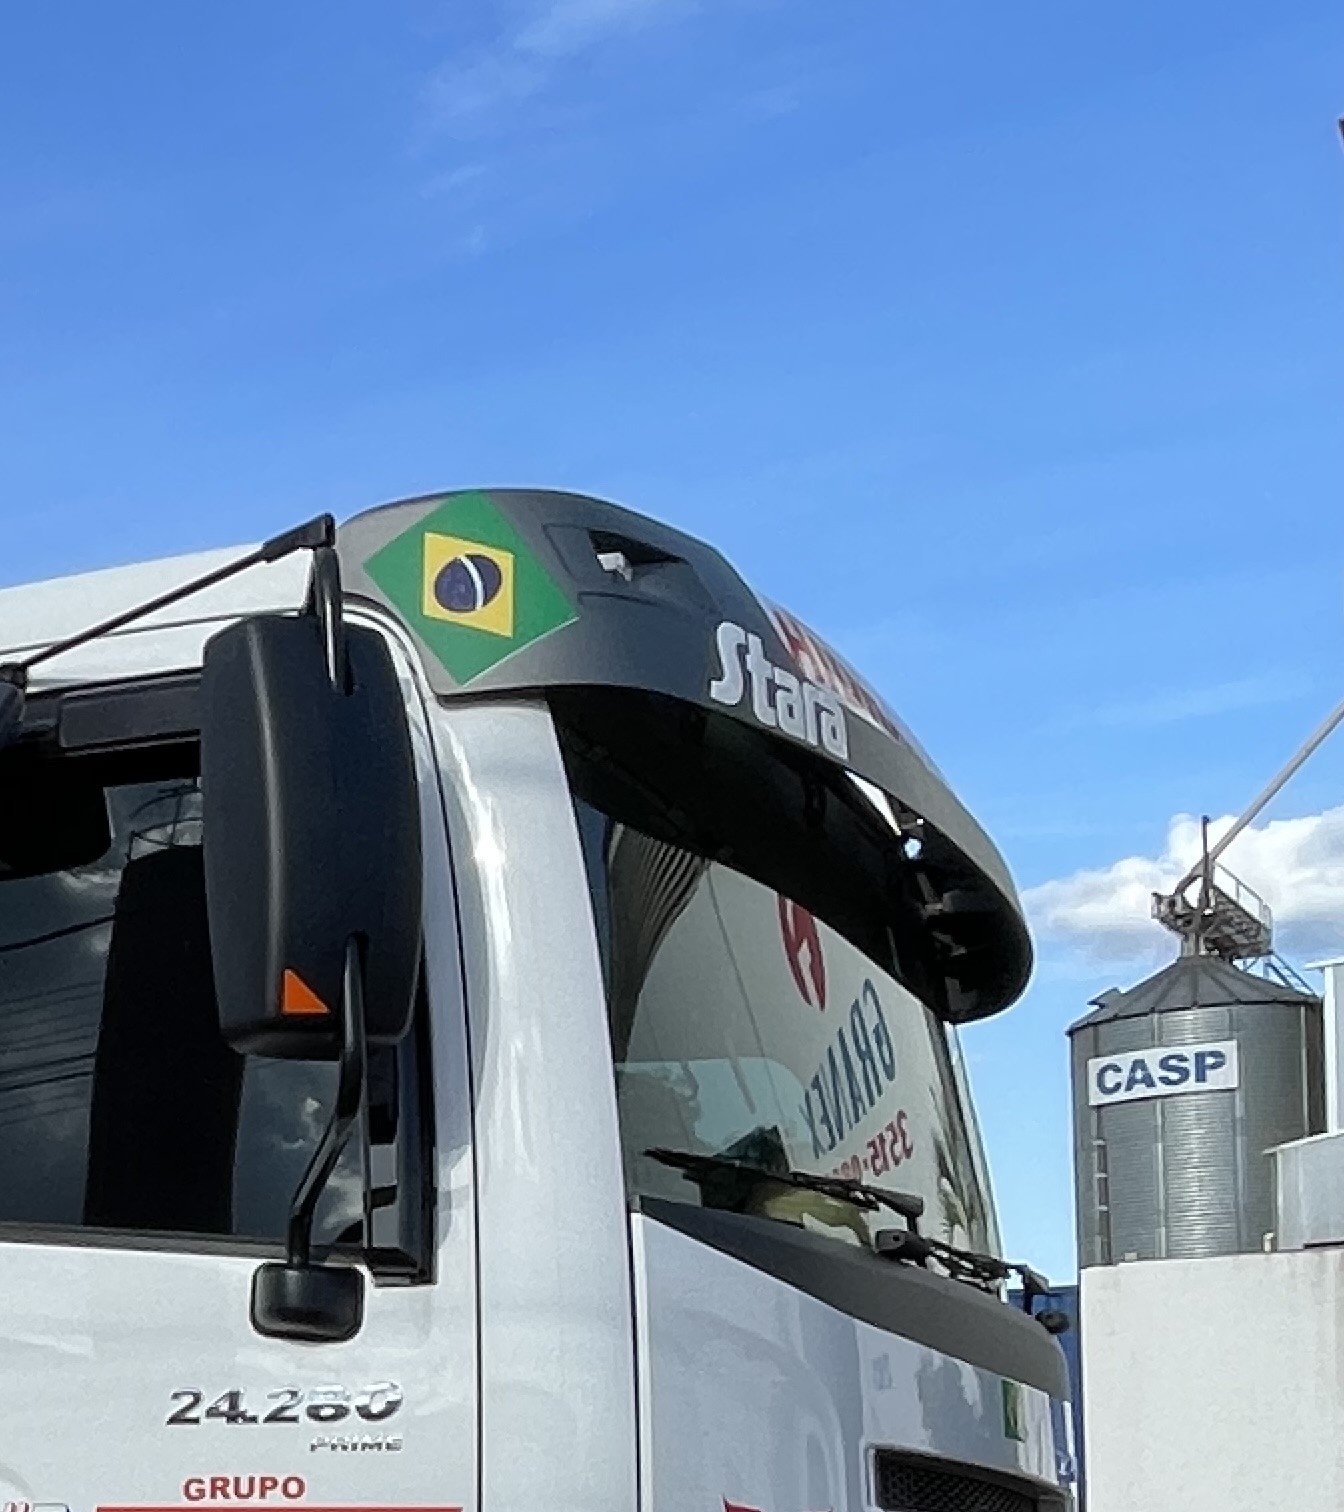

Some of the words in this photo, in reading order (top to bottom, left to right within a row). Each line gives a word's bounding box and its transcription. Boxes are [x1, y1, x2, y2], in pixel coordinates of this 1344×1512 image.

[711, 621, 849, 760] Stara
[1096, 1049, 1226, 1095] CASP
[166, 1380, 403, 1426] 24.280
[182, 1476, 306, 1501] GRUPO
